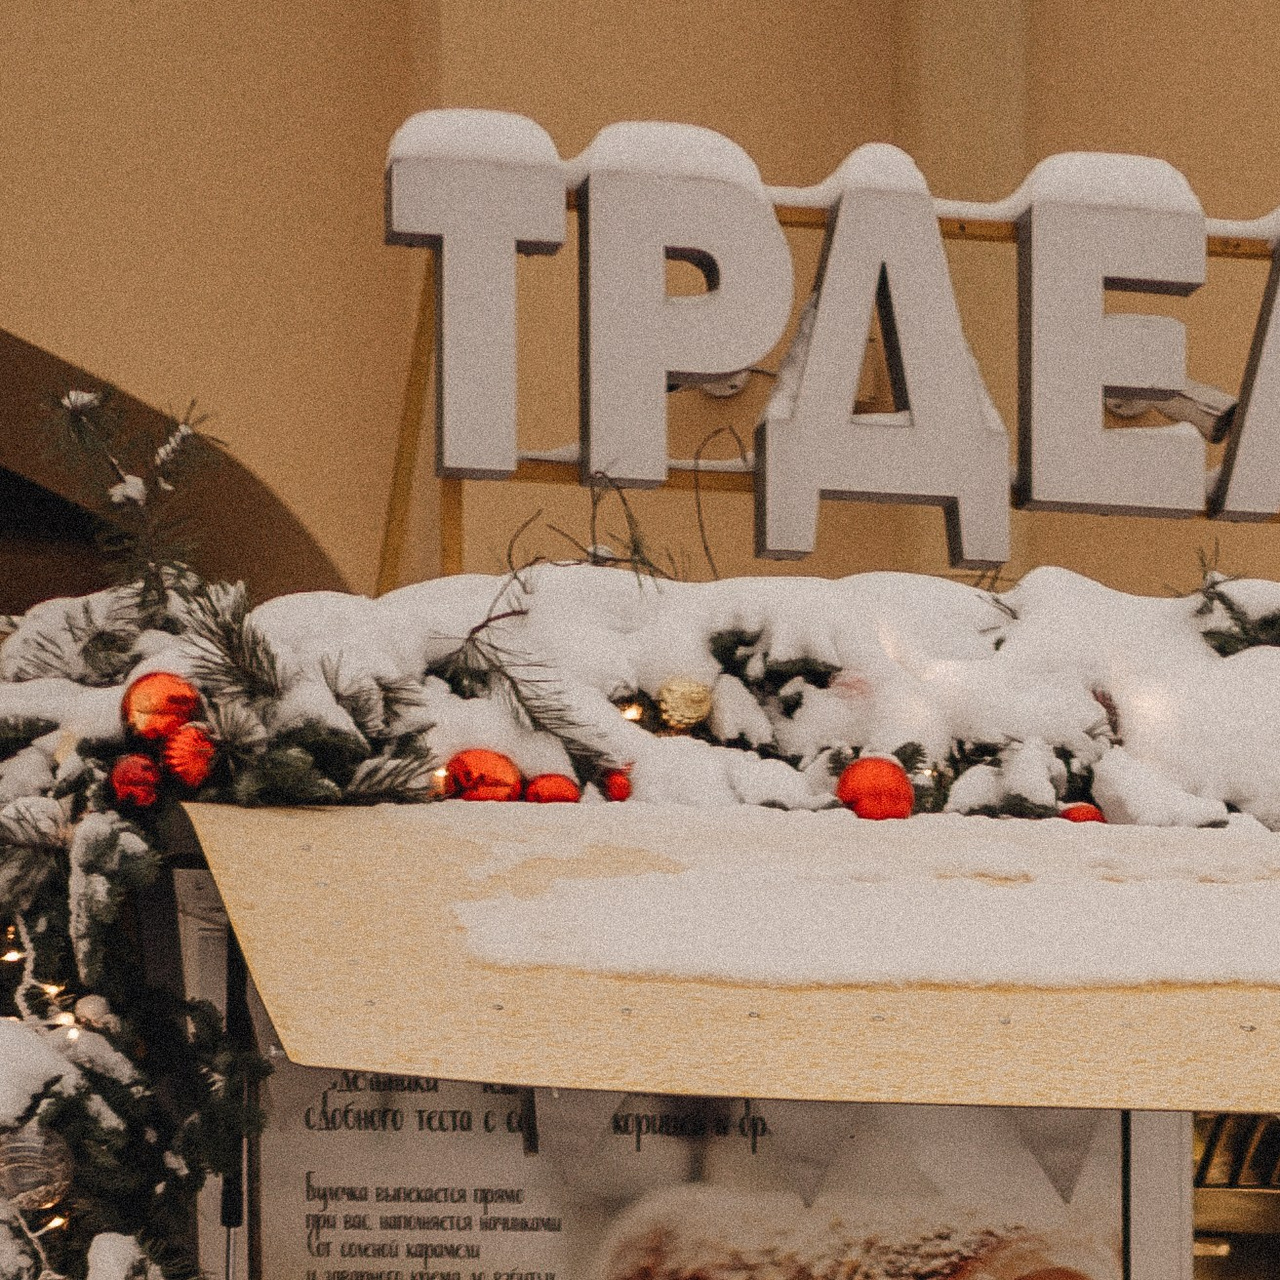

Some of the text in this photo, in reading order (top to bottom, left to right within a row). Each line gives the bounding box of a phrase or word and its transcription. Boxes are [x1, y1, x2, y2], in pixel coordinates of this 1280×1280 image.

[304, 1082, 403, 1132] сдобного
[416, 1108, 472, 1132] теста
[483, 1108, 496, 1133] с
